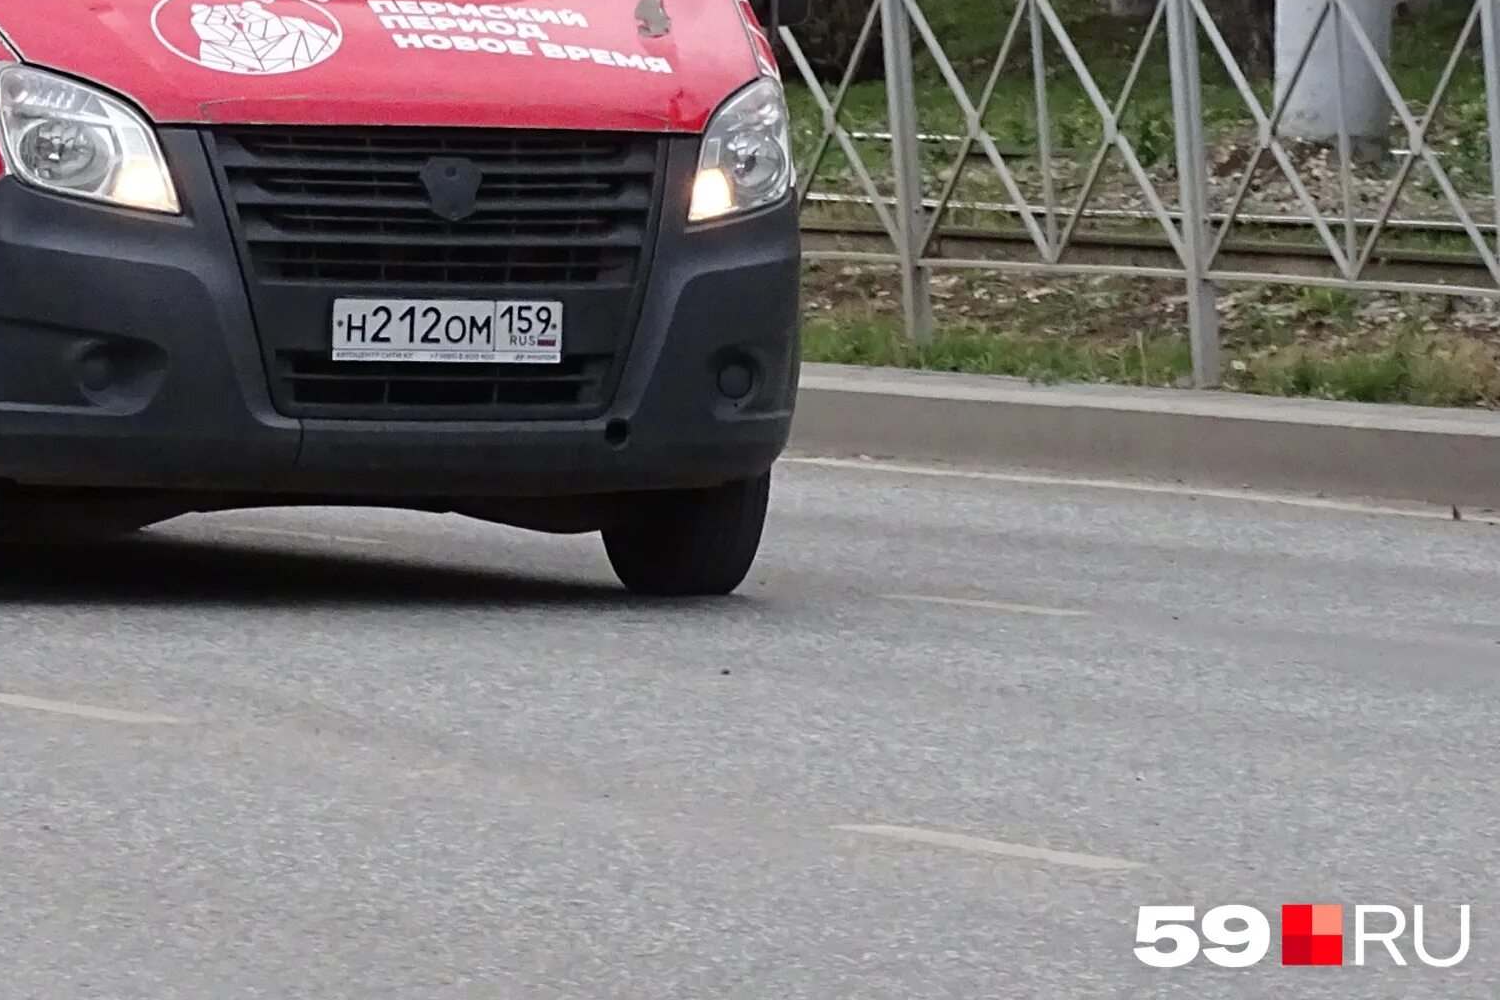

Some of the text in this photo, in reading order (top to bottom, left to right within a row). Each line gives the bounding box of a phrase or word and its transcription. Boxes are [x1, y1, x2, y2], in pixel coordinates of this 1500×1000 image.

[367, 0, 589, 28] ПЕРМСКИЙ
[379, 14, 550, 40] ПЕРИОД
[392, 33, 673, 73] НОВОЕ ВРЕМЯ
[500, 306, 551, 334] 159
[510, 335, 536, 346] RUS
